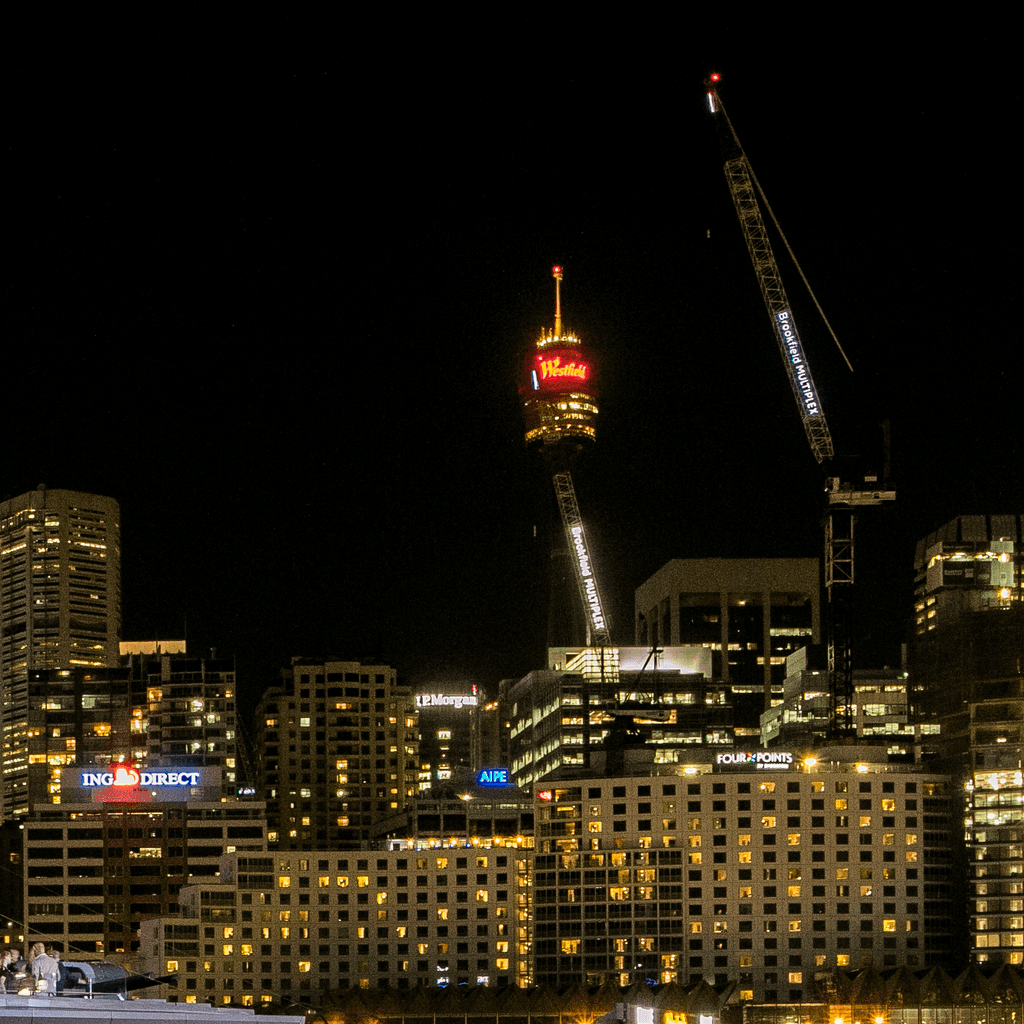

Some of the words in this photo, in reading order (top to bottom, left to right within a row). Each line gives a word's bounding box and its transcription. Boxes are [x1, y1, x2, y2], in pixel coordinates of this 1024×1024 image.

[541, 357, 586, 379] Westfield
[778, 311, 802, 364] Brookfield
[796, 364, 819, 415] MULTIPLEX
[584, 578, 605, 630] MULTIPLEX
[717, 753, 747, 764] FOUR
[756, 752, 793, 764] POINTS
[82, 773, 114, 786] ING
[139, 772, 199, 785] DIRECT
